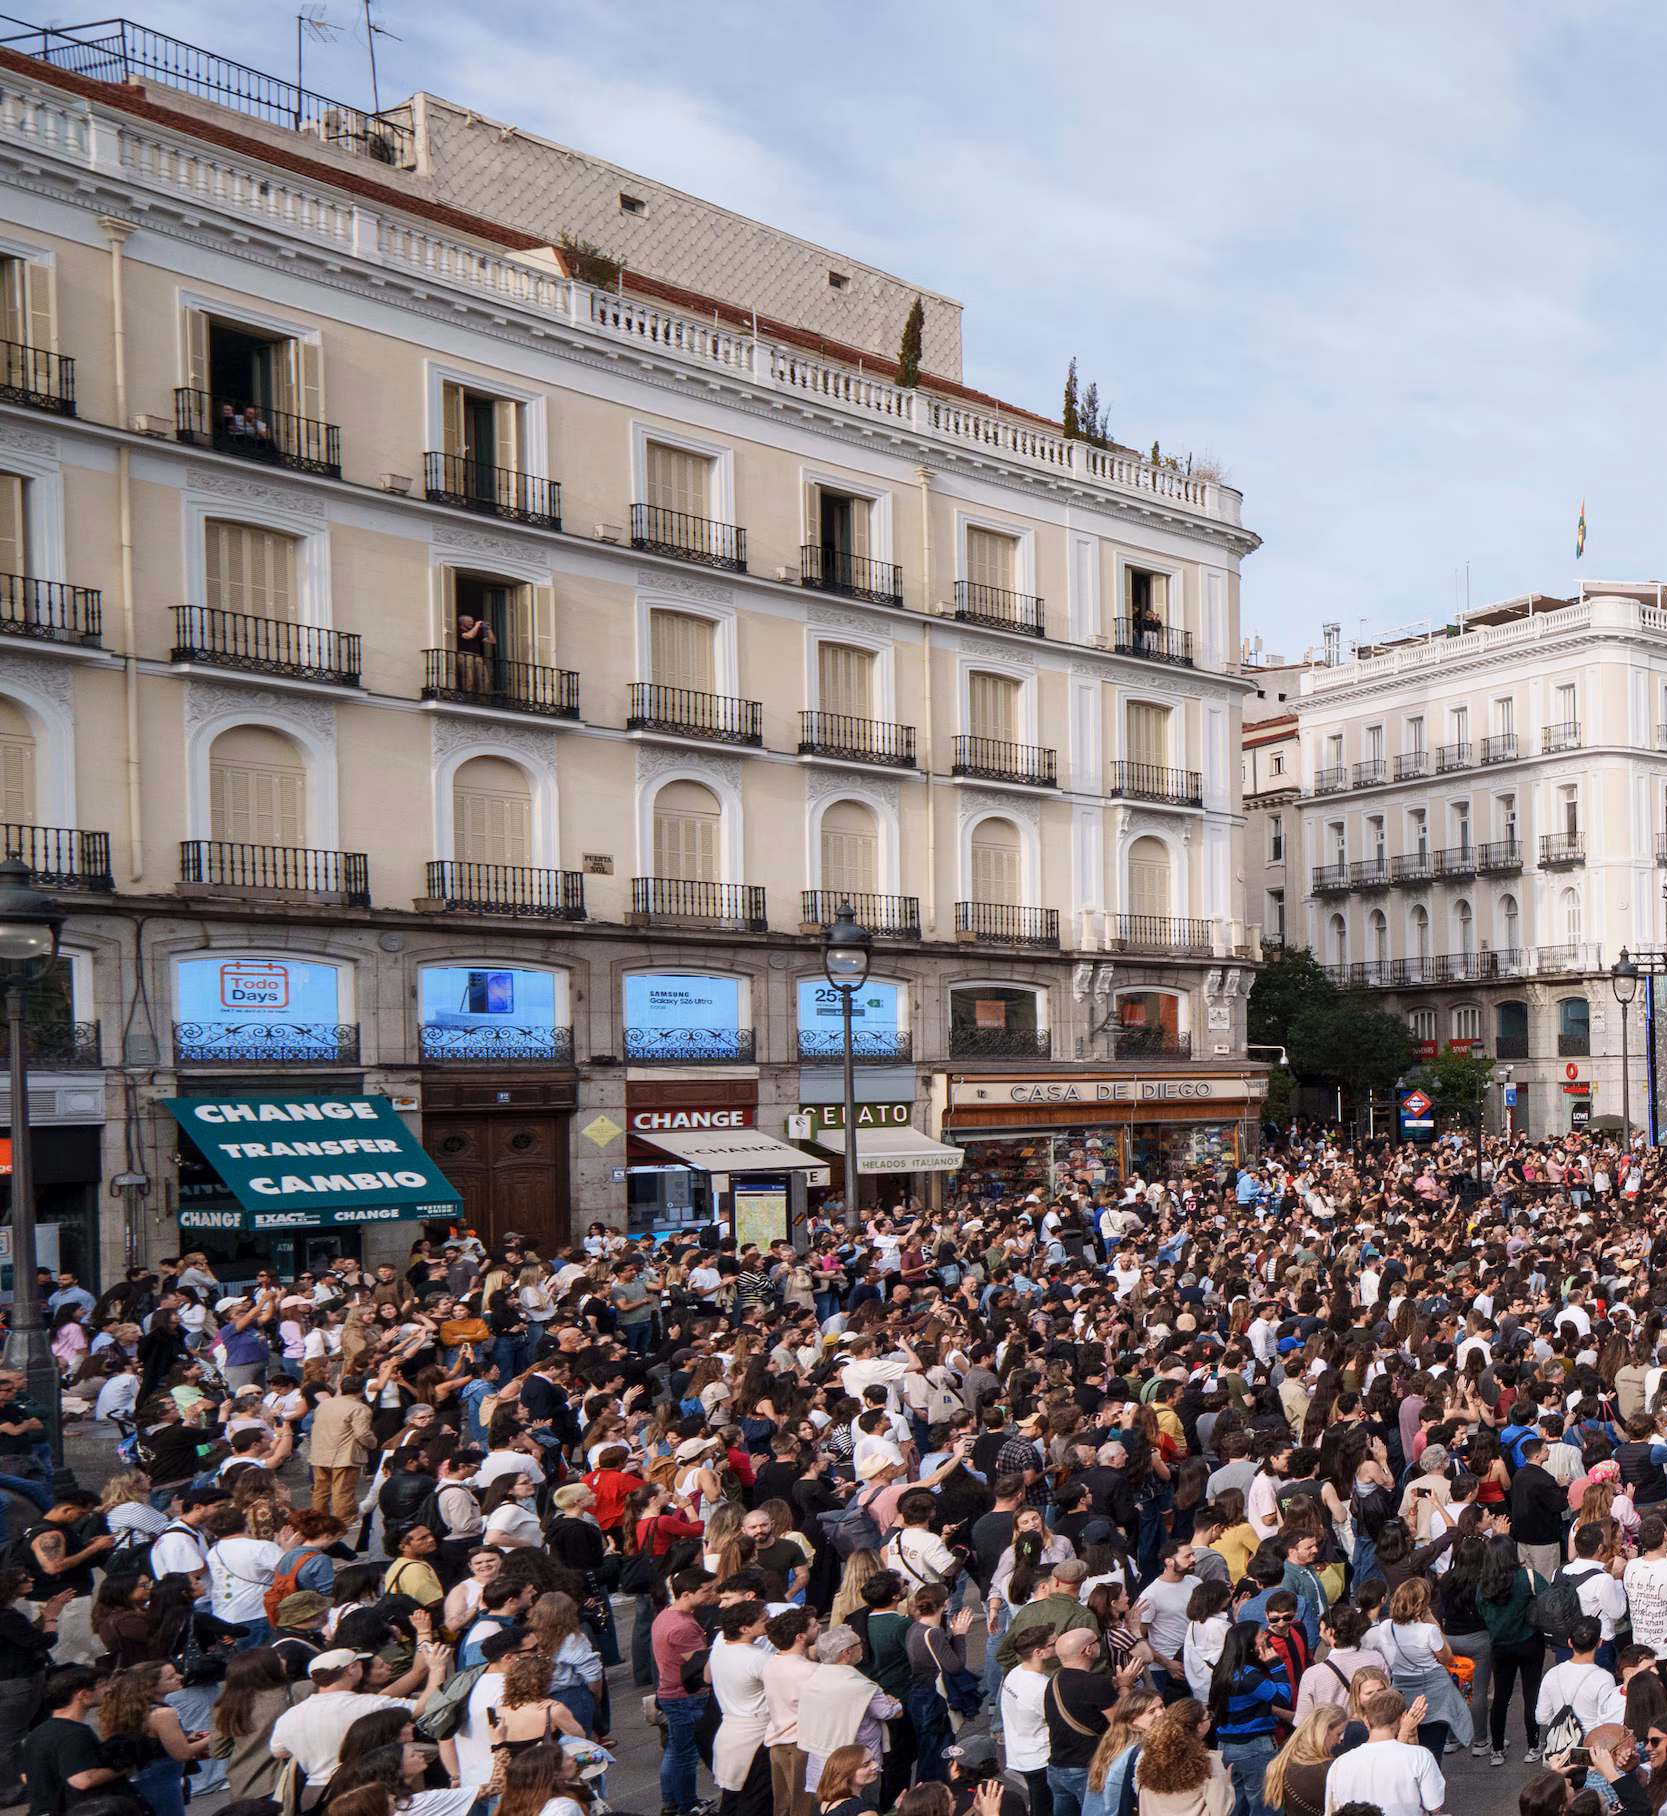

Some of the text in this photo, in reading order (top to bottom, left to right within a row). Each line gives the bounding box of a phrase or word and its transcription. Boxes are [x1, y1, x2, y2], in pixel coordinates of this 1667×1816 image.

[231, 978, 278, 989] Todo
[232, 990, 277, 1003] Days
[649, 990, 690, 998] SAMSUNG
[649, 998, 678, 1006] Galaxy
[1010, 1082, 1212, 1102] CASA DE DIEGO
[194, 1101, 379, 1123] CHANGE
[633, 1110, 744, 1130] CHANGE
[218, 1138, 403, 1159] TRANSFER
[694, 1144, 790, 1156] CHANGE
[862, 1157, 960, 1169] HELADOS ITALIANOS
[249, 1171, 428, 1195] CAMBIO
[180, 1211, 242, 1228] CHANGE
[334, 1208, 400, 1221] CHANGE
[277, 1242, 294, 1252] ATM
